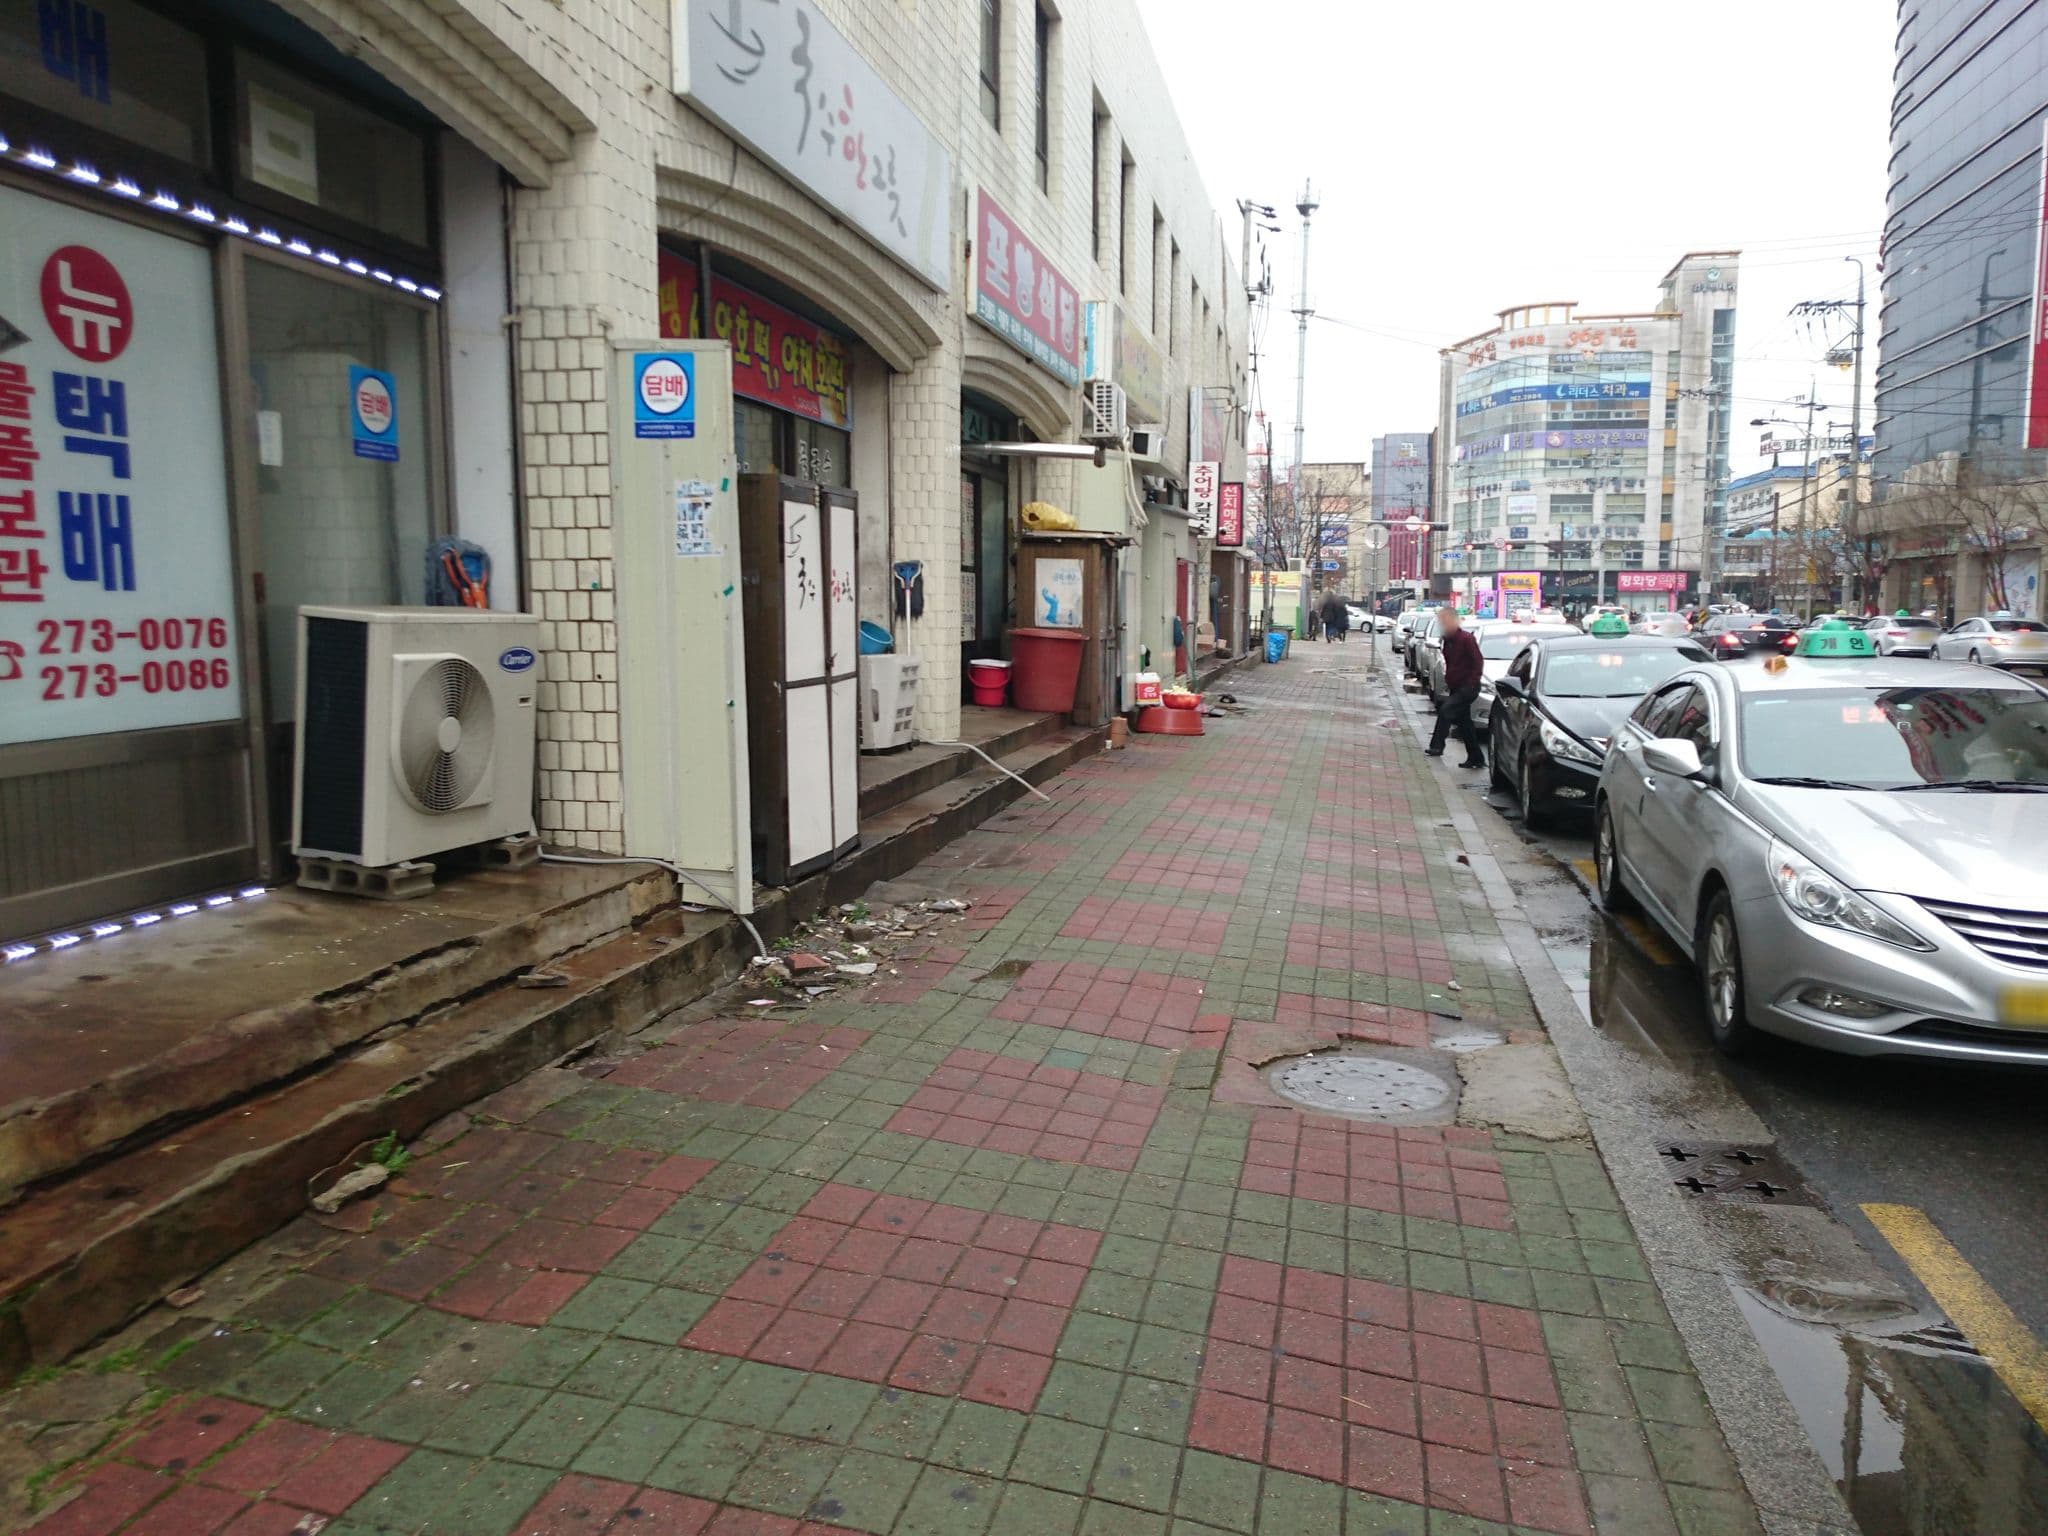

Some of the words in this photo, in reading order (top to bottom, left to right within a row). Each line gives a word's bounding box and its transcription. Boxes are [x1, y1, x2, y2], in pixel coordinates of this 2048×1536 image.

[985, 211, 1076, 353] 포항식당
[1565, 327, 1605, 348] 365
[645, 375, 684, 396] 담배
[1568, 386, 1600, 399] 리더스
[1602, 383, 1628, 397] 치과
[1194, 464, 1214, 499] 추어탕
[1620, 575, 1657, 587] 평화당
[37, 618, 227, 655] 273-0076
[1819, 637, 1865, 650] 개인
[502, 652, 532, 667] Carrier
[40, 658, 229, 701] 273-0086
